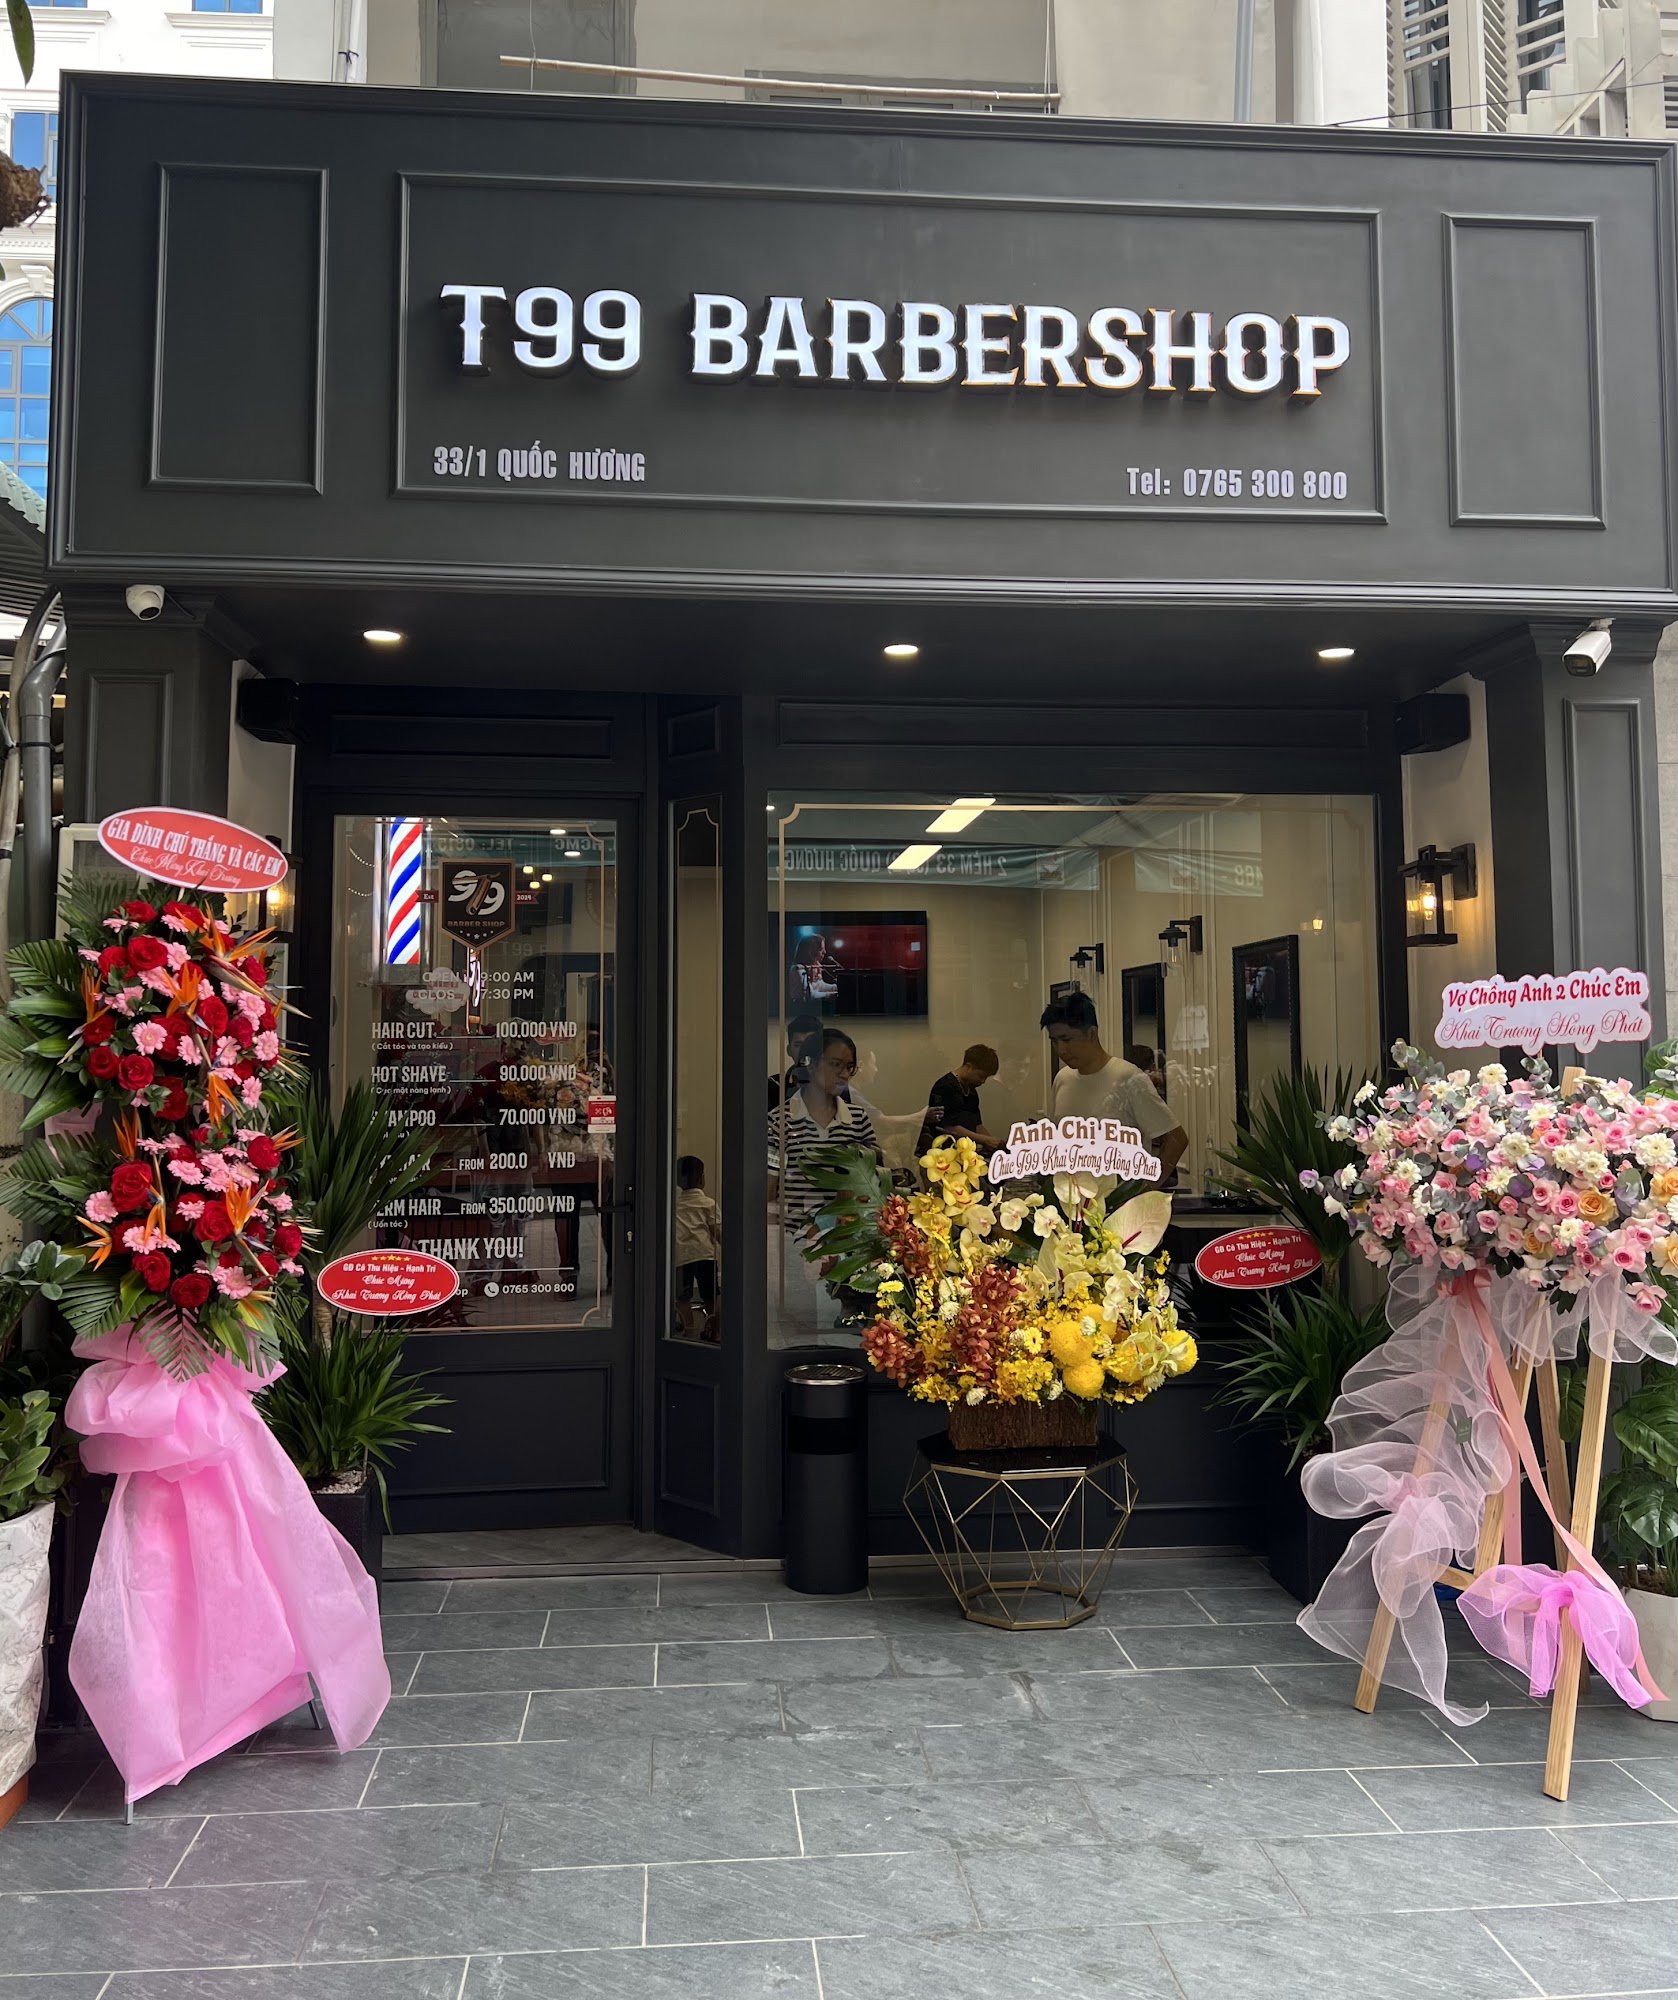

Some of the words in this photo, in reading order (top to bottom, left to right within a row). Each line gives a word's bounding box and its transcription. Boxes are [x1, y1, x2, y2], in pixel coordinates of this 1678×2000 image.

[440, 284, 642, 372] T99
[688, 292, 1352, 396] BARBERSHOP
[433, 445, 487, 477] 33/1
[497, 440, 557, 482] QUỐC
[569, 448, 646, 481] HƯƠNG
[1126, 467, 1171, 496] Tel:
[1183, 468, 1243, 498] 0765
[1251, 469, 1295, 499] 300
[1303, 470, 1348, 500] 800
[107, 817, 131, 841] GIA
[130, 820, 165, 850] ĐÌNH
[163, 830, 191, 856] CHÚ
[188, 835, 227, 864] THẮNG
[227, 845, 244, 869] VÀ
[243, 848, 266, 873] CÁC
[264, 856, 284, 878] EM
[513, 971, 535, 983] AM
[513, 988, 534, 1000] PM
[1448, 989, 1466, 1012] Vợ
[1469, 981, 1517, 1008] Chồng
[1520, 983, 1552, 1002] Anh
[1556, 984, 1566, 1001] 2
[1570, 976, 1611, 999] Chúc
[1614, 975, 1641, 997] Em
[371, 1022, 406, 1039] HAIR
[495, 1021, 547, 1038] 100.000
[549, 1021, 577, 1038] VND
[1440, 1018, 1481, 1042] Khai
[1601, 1009, 1644, 1034] Phát
[371, 1065, 399, 1083] HOT
[401, 1065, 446, 1083] SHAVE
[499, 1064, 547, 1082] 90.000
[549, 1064, 577, 1081] VND
[499, 1108, 545, 1126] 70.000
[548, 1107, 576, 1125] VND
[1010, 1122, 1053, 1147] Anh
[1062, 1120, 1096, 1146] Chị
[1104, 1122, 1138, 1146] Em
[458, 1158, 484, 1171] FROM
[548, 1151, 576, 1169] VND
[992, 1154, 1015, 1180] Chúc
[1016, 1149, 1039, 1173] T99
[1042, 1145, 1067, 1171] Khai
[1103, 1146, 1131, 1177] Hồng
[1132, 1151, 1158, 1178] Phát
[408, 1198, 442, 1216] HAIR
[460, 1203, 486, 1216] FROM
[489, 1196, 543, 1214] 350.000
[547, 1195, 575, 1213] VND
[418, 1238, 481, 1260] THANK
[483, 1236, 524, 1259] YOU!
[1237, 1243, 1249, 1251] Thu
[367, 1263, 380, 1272] Thu
[332, 1289, 357, 1301] Khai
[502, 1284, 529, 1294] 0765
[531, 1283, 552, 1293] 300
[553, 1282, 575, 1292] 800
